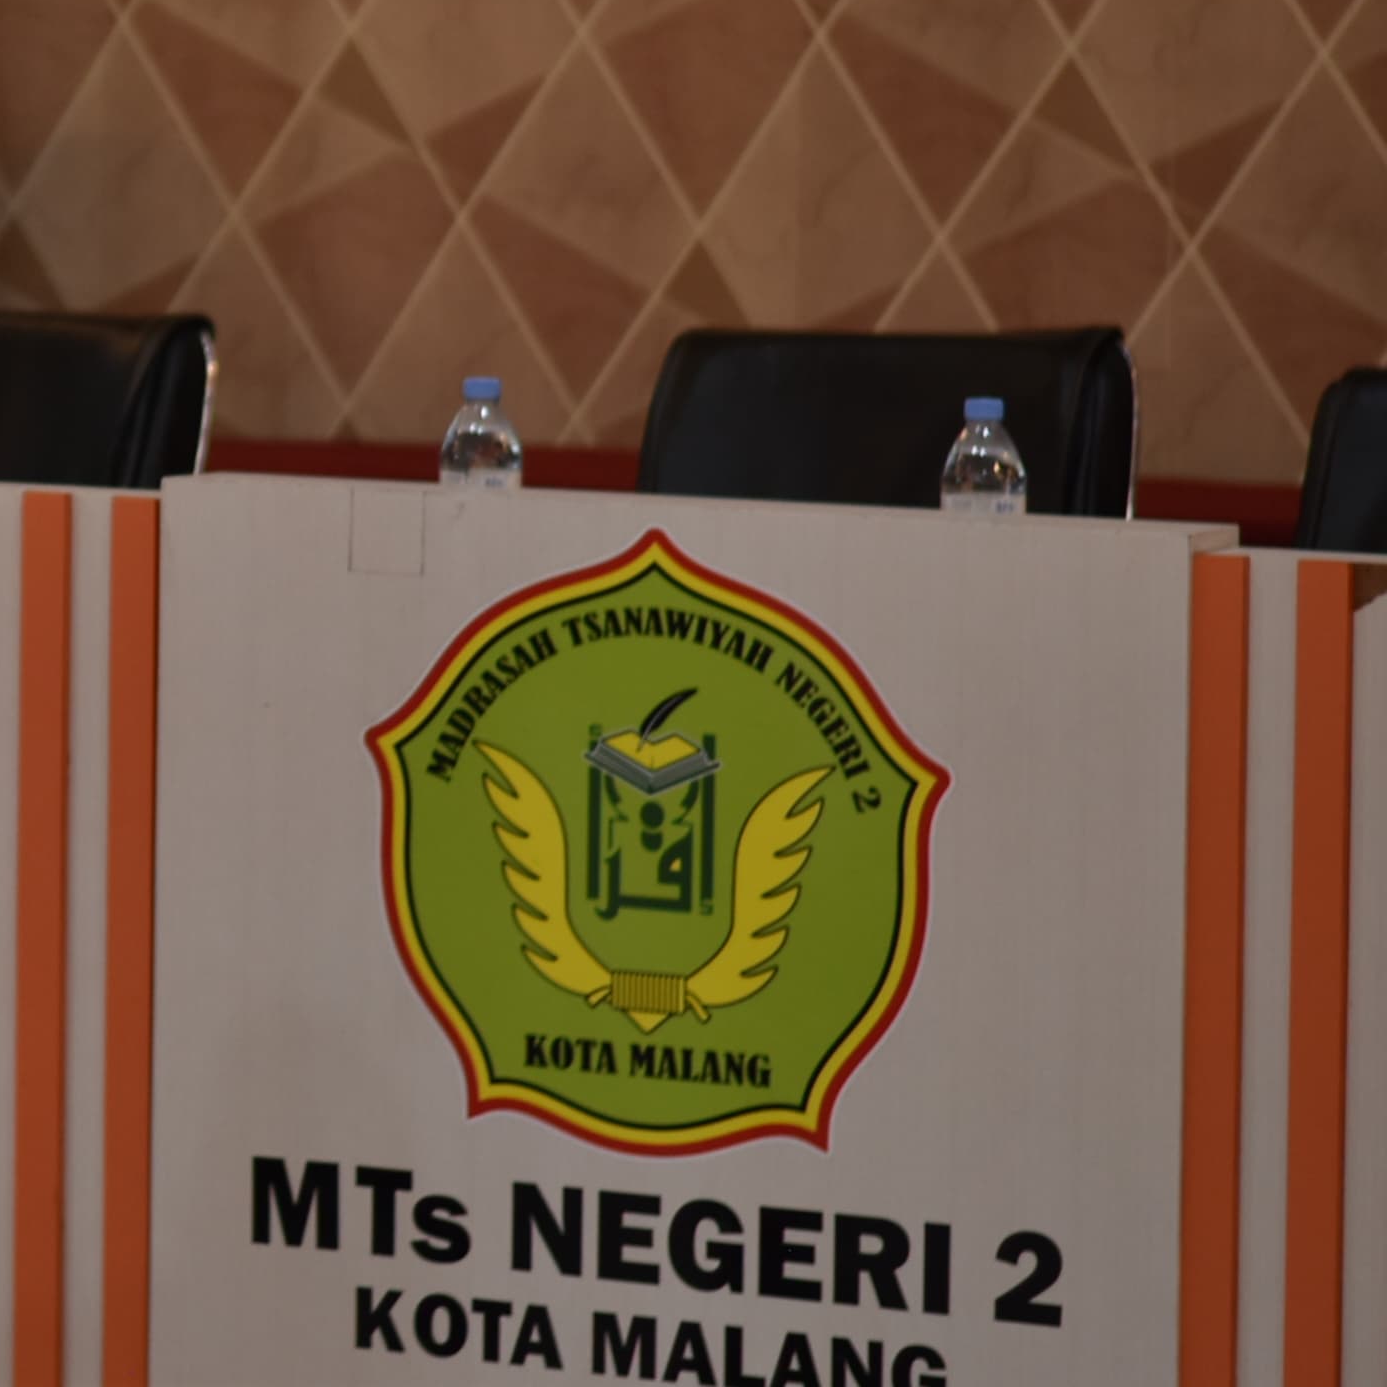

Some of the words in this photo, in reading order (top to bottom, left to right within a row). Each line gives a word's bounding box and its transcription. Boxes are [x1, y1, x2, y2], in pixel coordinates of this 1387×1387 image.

[426, 629, 559, 782] MADRASAH
[561, 606, 775, 674] TSANAWIYAH
[774, 660, 872, 781] NEGERI
[850, 785, 884, 815] 2
[524, 1033, 618, 1075] KOTA
[629, 1043, 772, 1088] MALANG
[250, 1155, 473, 1265] MTs
[510, 1180, 953, 1318] NEGERI
[993, 1230, 1064, 1329] 2
[353, 1286, 565, 1372] KOTA
[590, 1311, 949, 1387] MALANG
